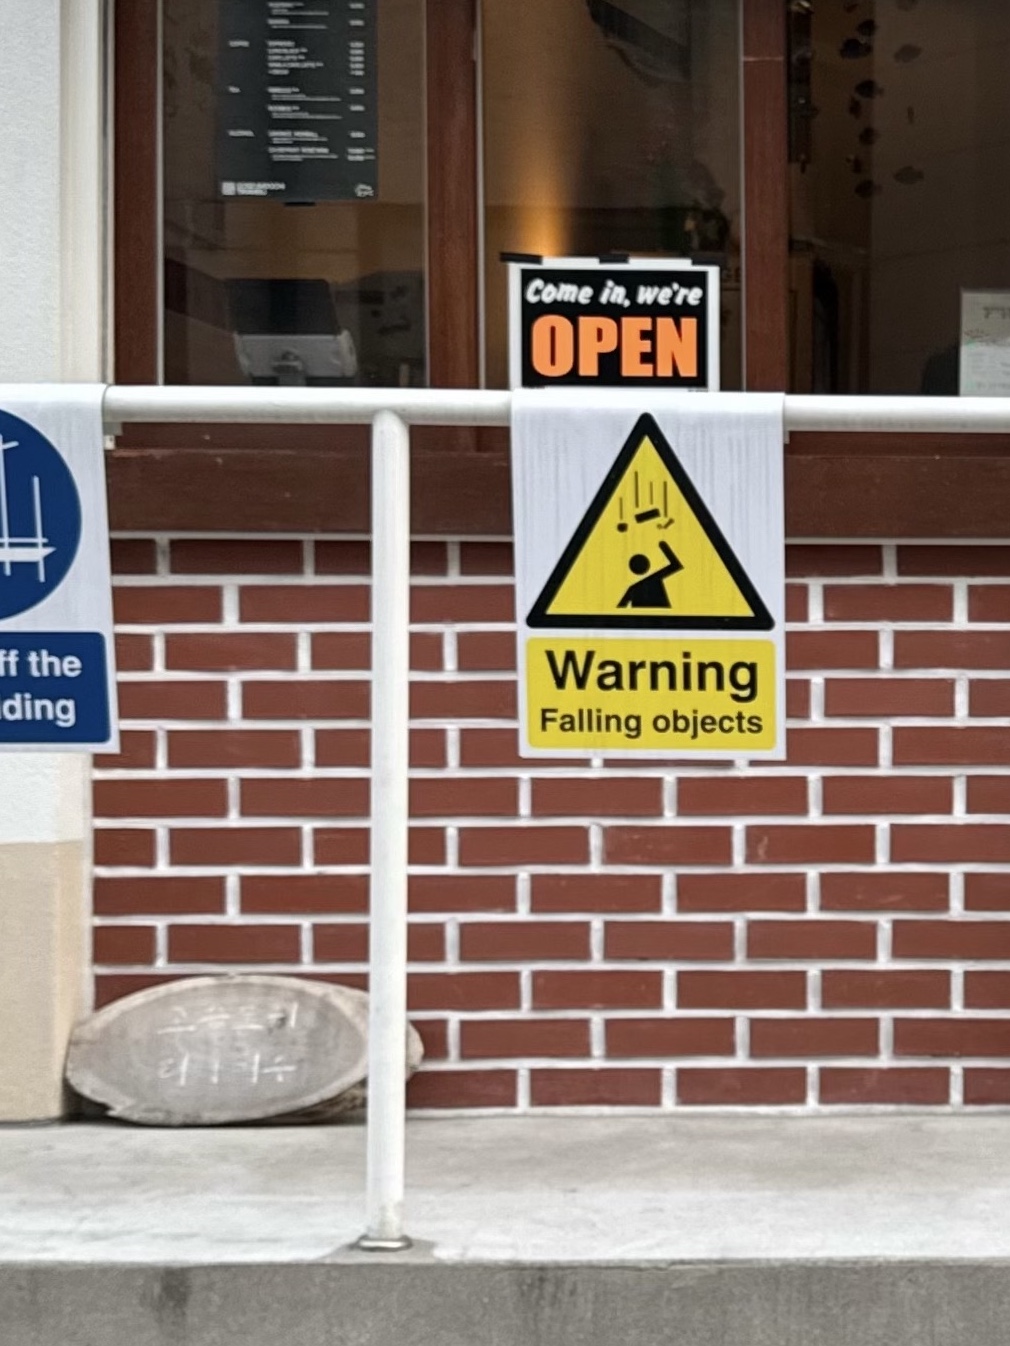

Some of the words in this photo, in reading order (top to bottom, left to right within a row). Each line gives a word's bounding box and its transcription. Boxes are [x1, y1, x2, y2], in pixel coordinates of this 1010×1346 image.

[525, 277, 594, 305] Come
[599, 278, 631, 308] in,
[636, 282, 704, 306] we're
[532, 314, 698, 378] OPEN
[27, 648, 83, 678] the
[544, 649, 759, 704] Warning
[0, 692, 77, 729] ding
[540, 707, 643, 740] Falling
[652, 709, 764, 741] objects
